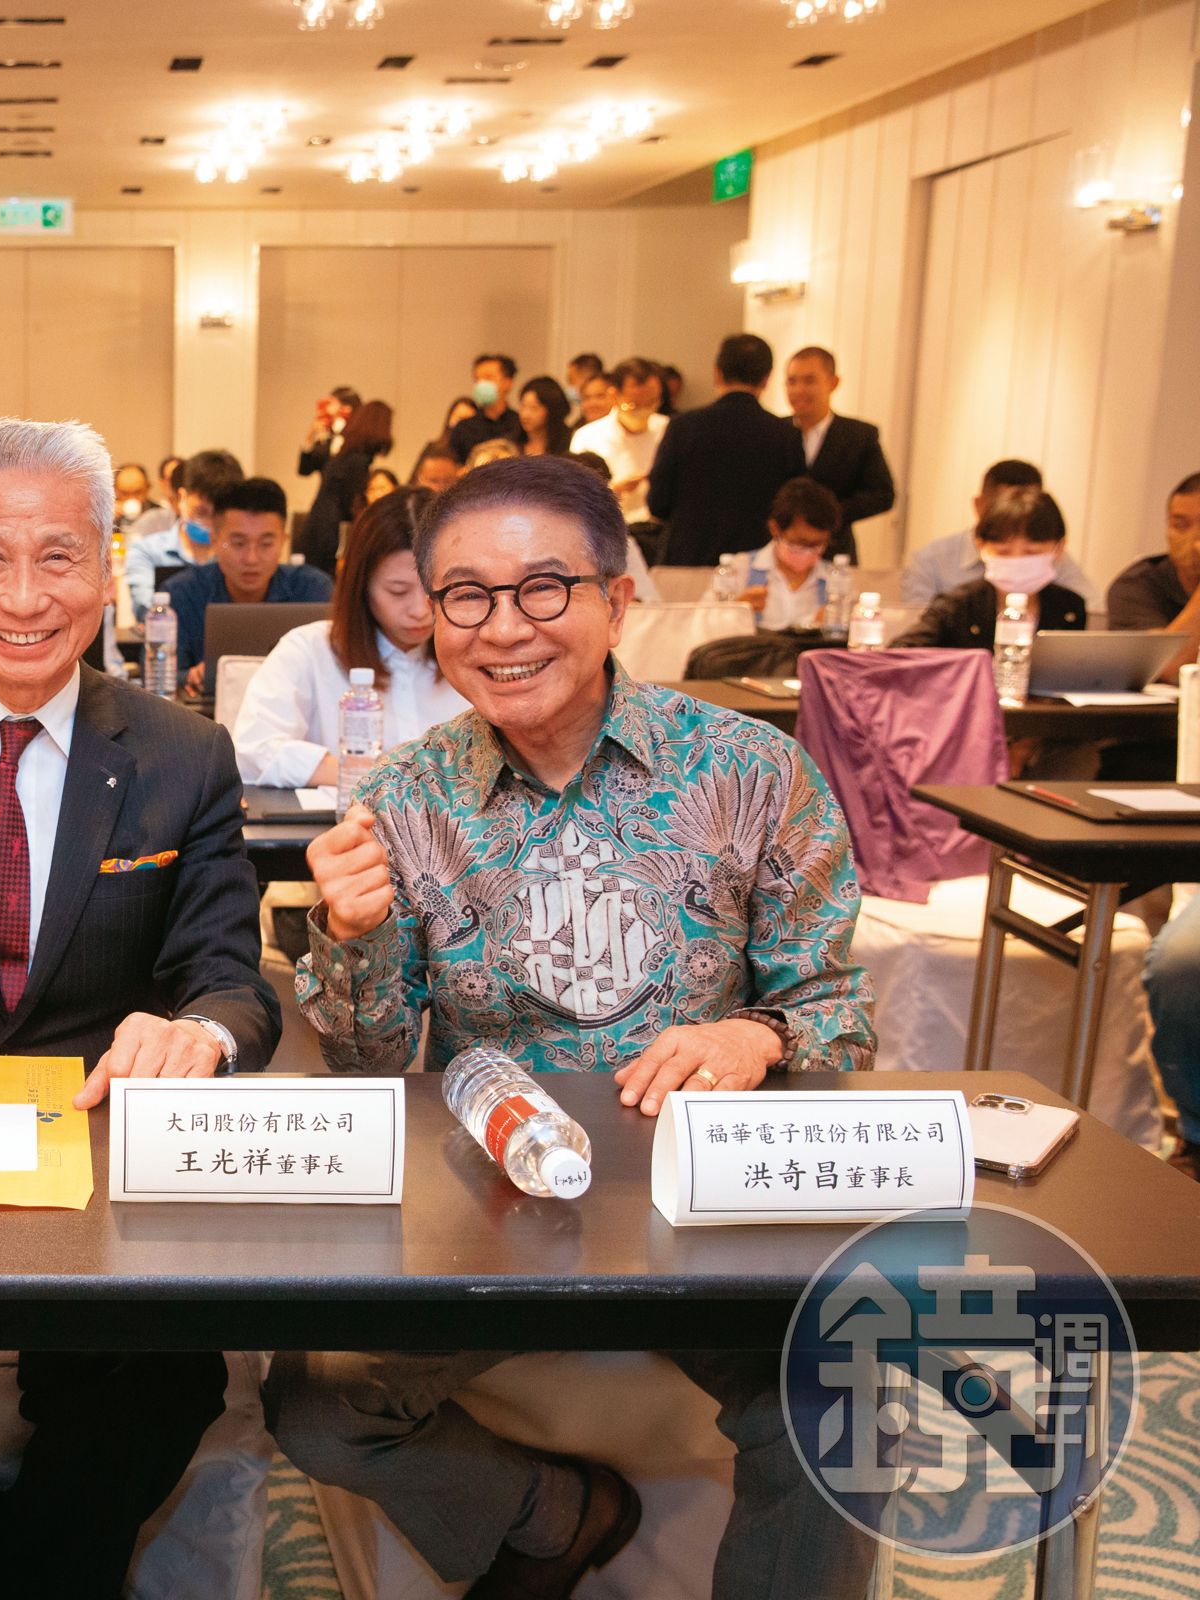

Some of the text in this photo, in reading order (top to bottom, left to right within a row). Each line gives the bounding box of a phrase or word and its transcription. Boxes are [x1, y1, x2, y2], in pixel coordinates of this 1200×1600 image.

[166, 1111, 353, 1133] 大同股份有限公司
[705, 1122, 944, 1144] 福華電子股份有限公司
[176, 1148, 343, 1175] 王光祥董事長
[744, 1159, 914, 1190] 洪奇昌董事長
